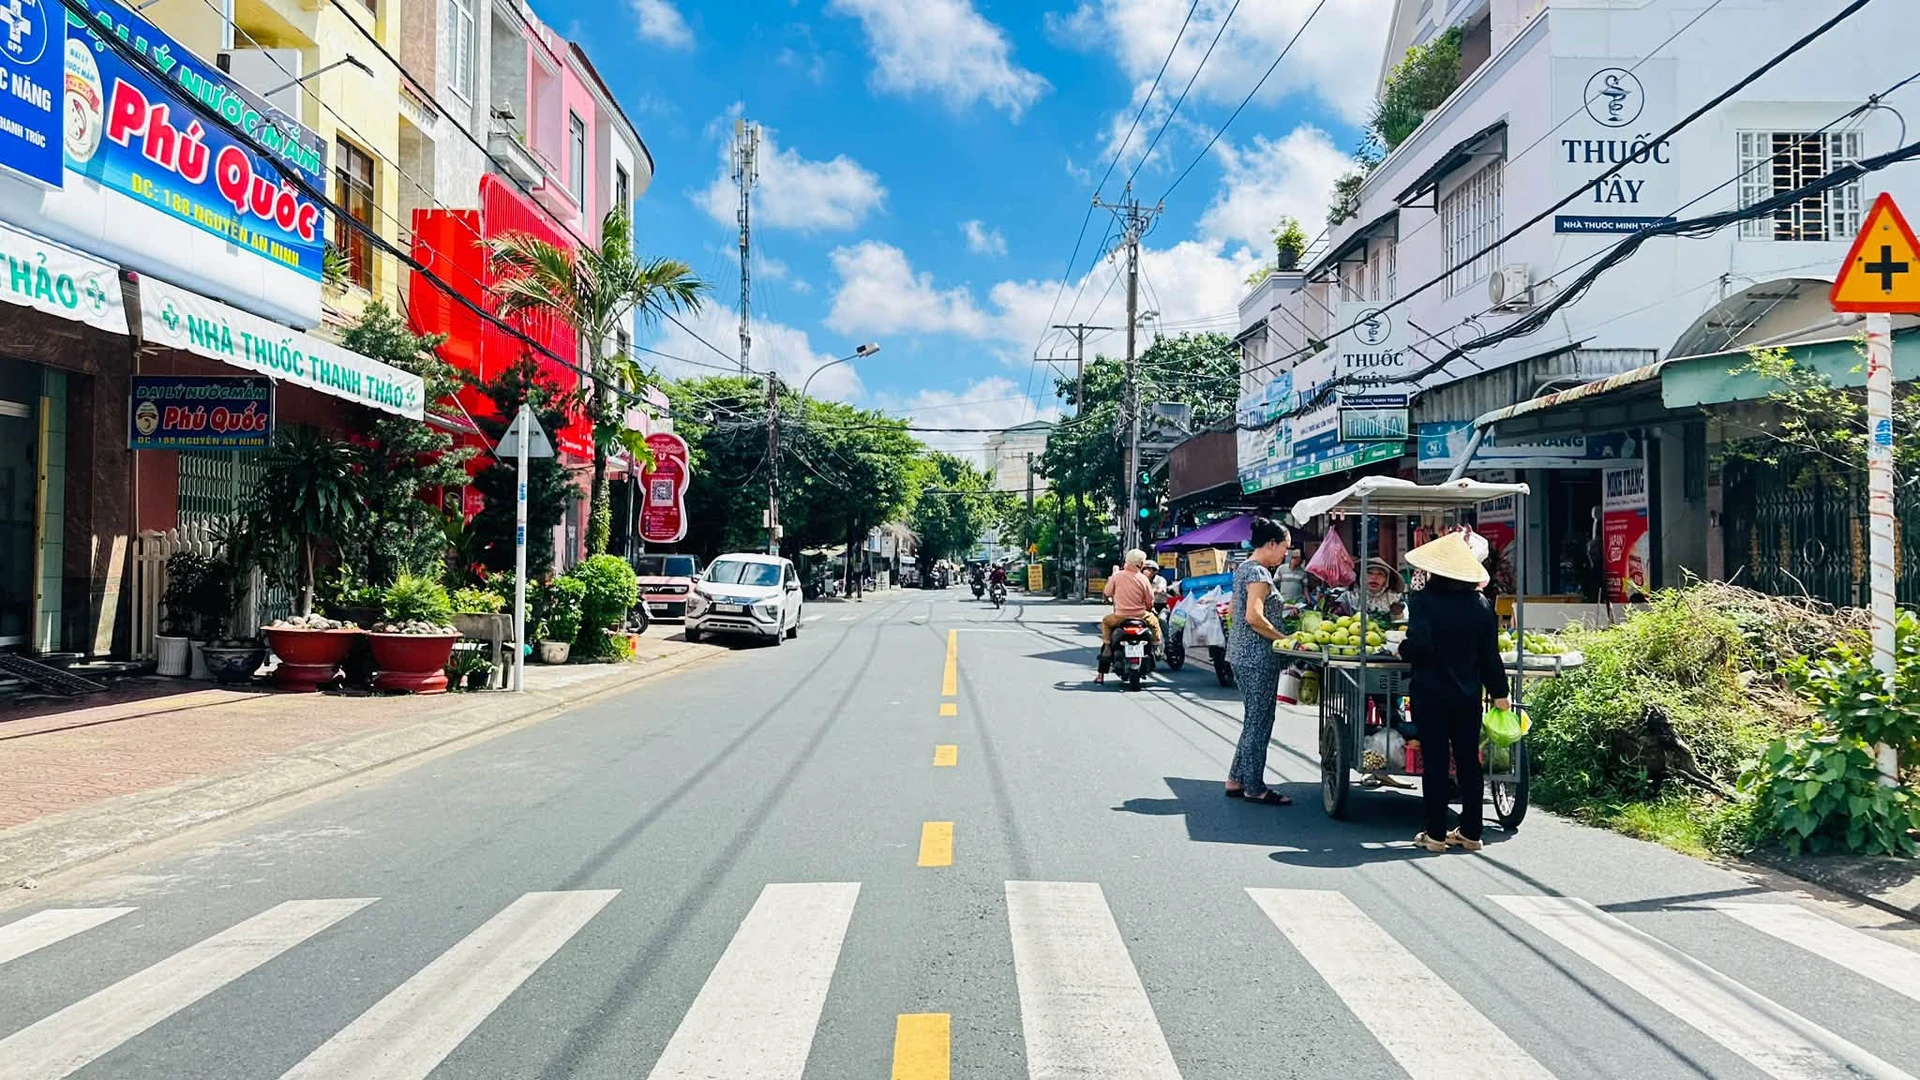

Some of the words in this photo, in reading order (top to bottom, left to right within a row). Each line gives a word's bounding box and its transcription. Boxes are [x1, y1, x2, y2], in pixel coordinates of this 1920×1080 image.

[8, 40, 23, 54] GPP
[12, 73, 51, 112] NĂNG
[24, 127, 46, 149] TRÚC
[1562, 133, 1670, 164] THUỐC
[106, 77, 210, 184] Phú
[215, 145, 319, 242] Quốc
[1589, 173, 1645, 204] TÂY
[164, 190, 190, 217] 188
[194, 203, 248, 245] NGUYỄN
[251, 232, 268, 253] AN
[270, 241, 299, 268] NINH
[1563, 219, 1582, 229] NHÀ
[1615, 222, 1639, 230] MINH
[187, 315, 236, 356] NHÀ
[241, 338, 305, 377] THUỐC
[308, 355, 362, 395] THANH
[366, 373, 404, 408] THẢO
[1343, 349, 1403, 367] THUỐC
[136, 386, 164, 401] ĐẠI
[164, 383, 185, 400] LÝ
[185, 383, 230, 400] NƯỚC
[163, 405, 207, 431] Phú
[210, 401, 268, 434] Quốc
[239, 437, 265, 446] NINH
